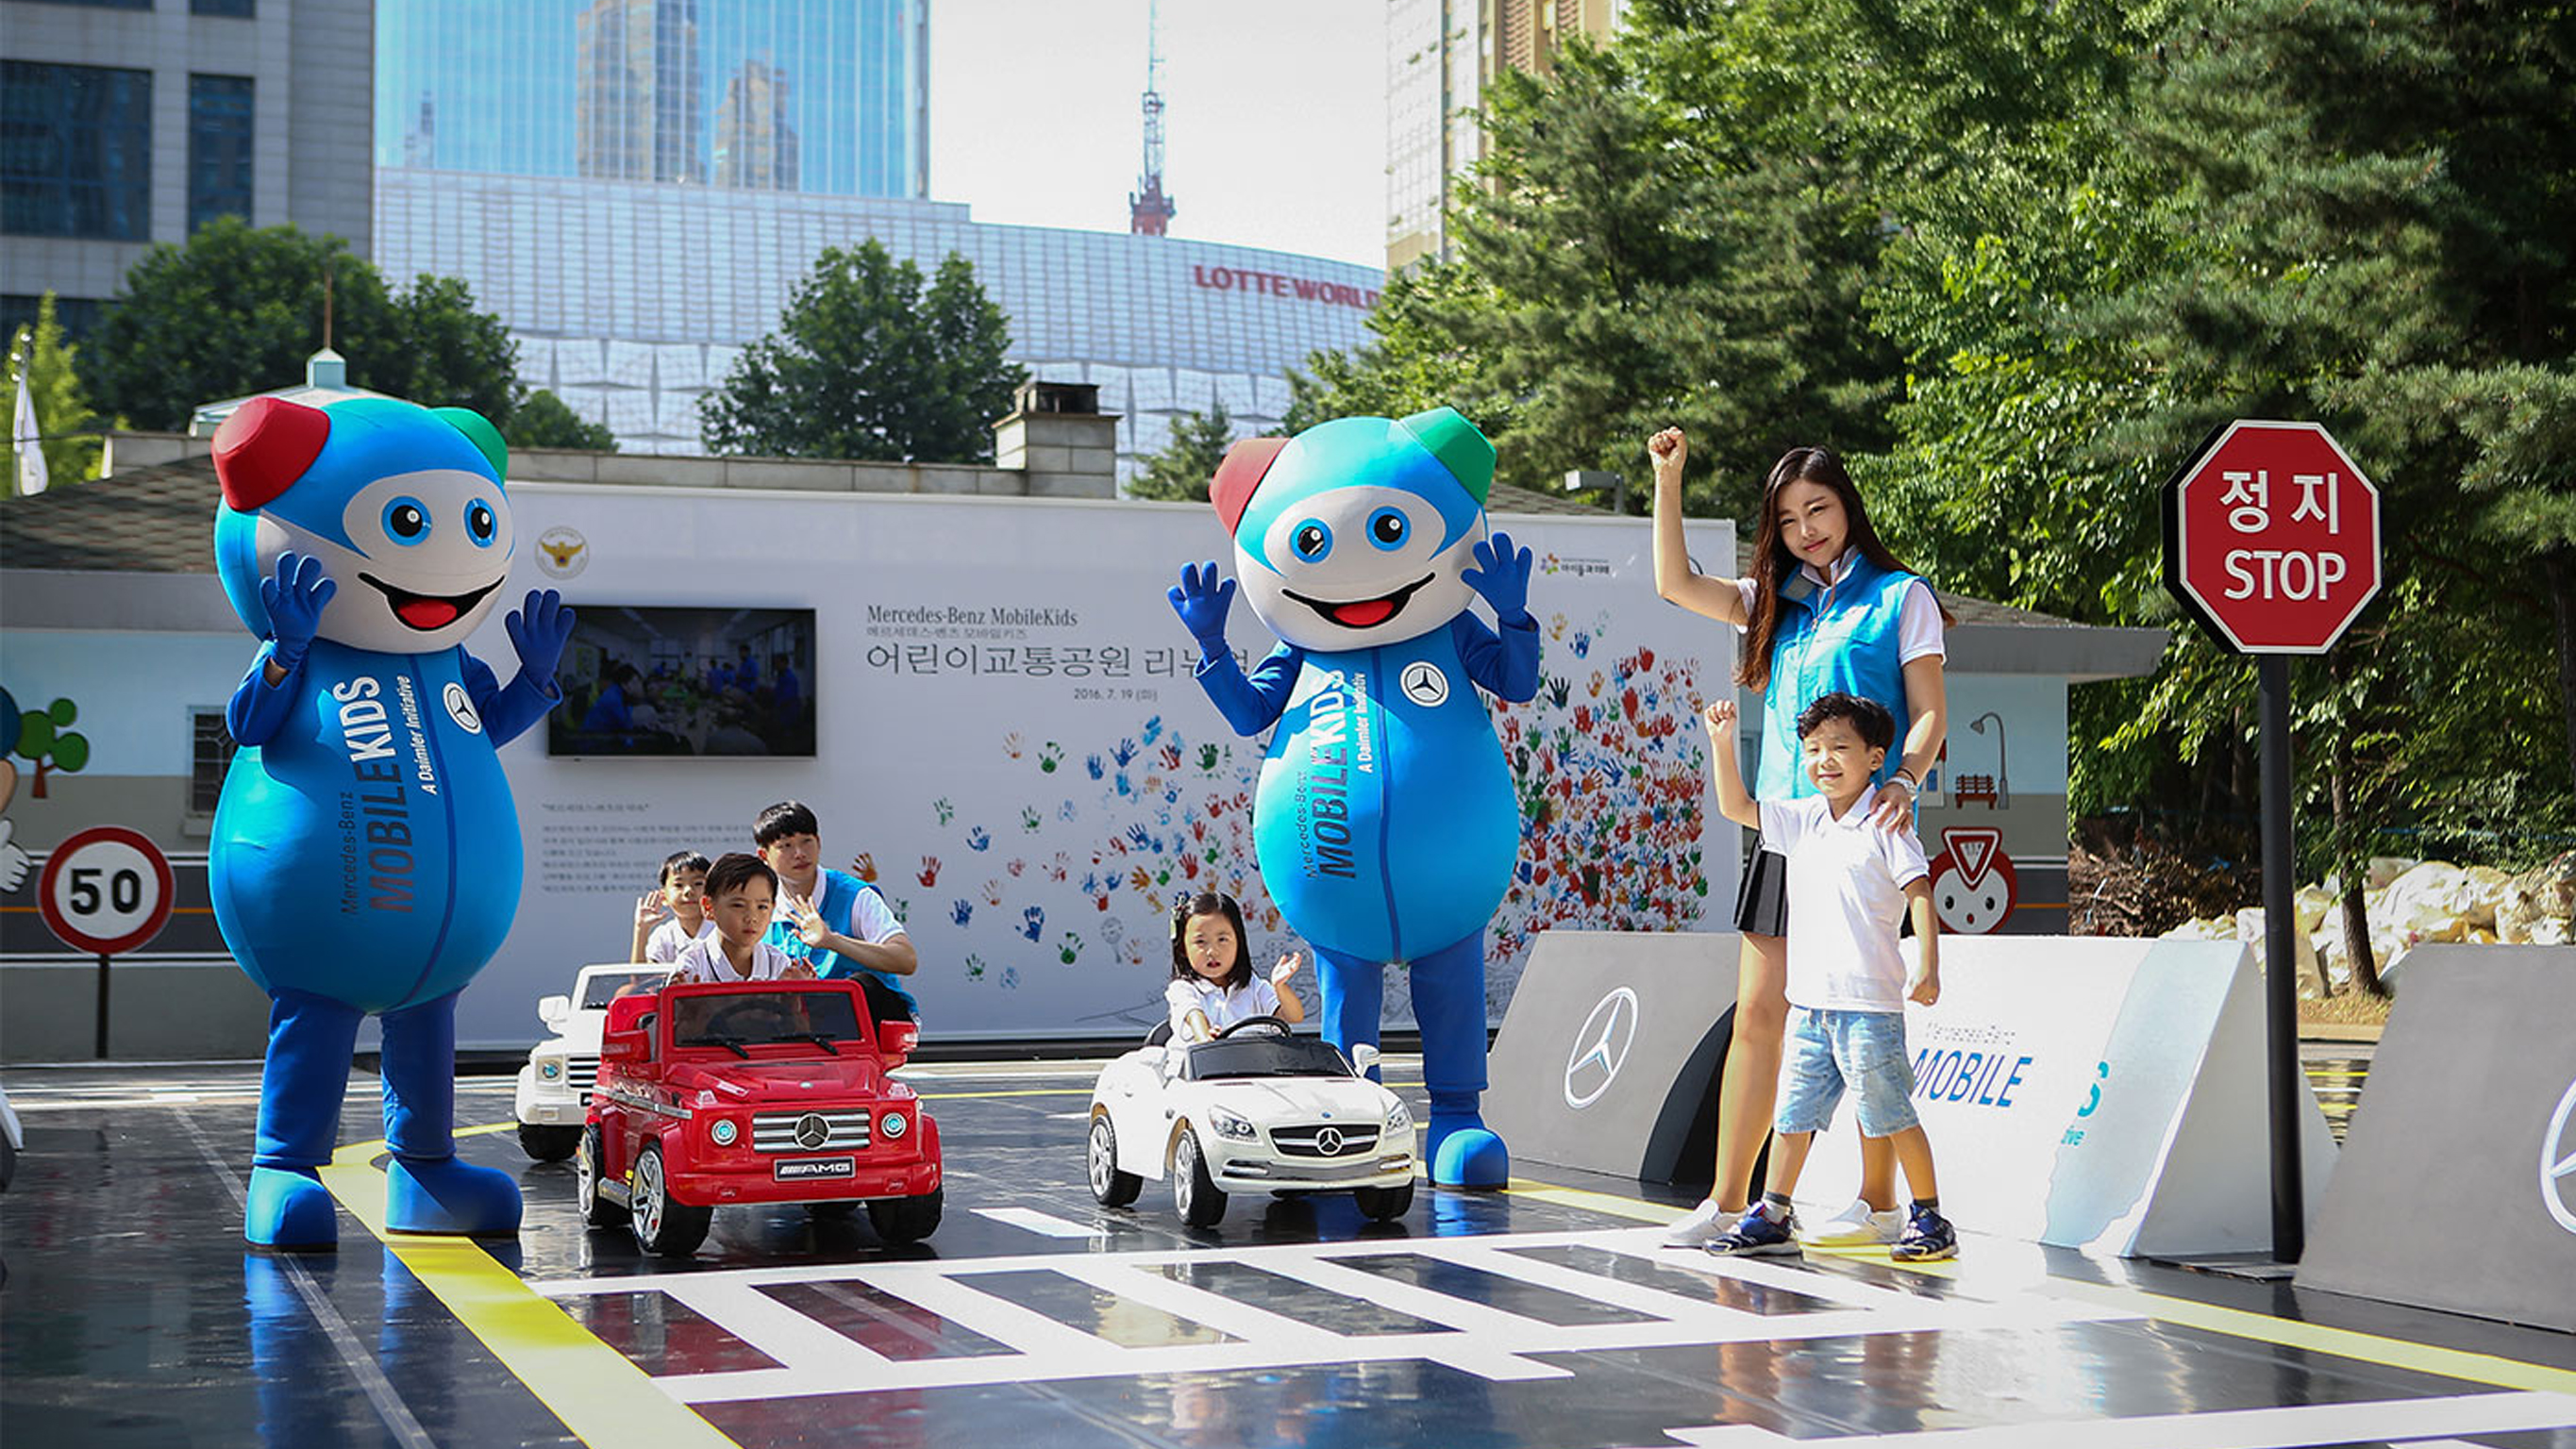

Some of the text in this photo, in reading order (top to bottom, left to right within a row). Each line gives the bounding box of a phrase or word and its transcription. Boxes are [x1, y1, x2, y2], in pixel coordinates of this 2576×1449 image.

[1195, 265, 1380, 309] LOTTE WORLD
[2224, 549, 2347, 601] STOP
[867, 605, 1079, 626] Mercedes-Benz MobileKids
[867, 643, 1130, 677] 어린이교통공원
[396, 675, 438, 795] A Daimler Initiative
[1354, 715, 1373, 761] Daimler
[1358, 762, 1373, 774] A
[339, 791, 358, 915] Mercedes-Benz
[71, 869, 142, 915] 50
